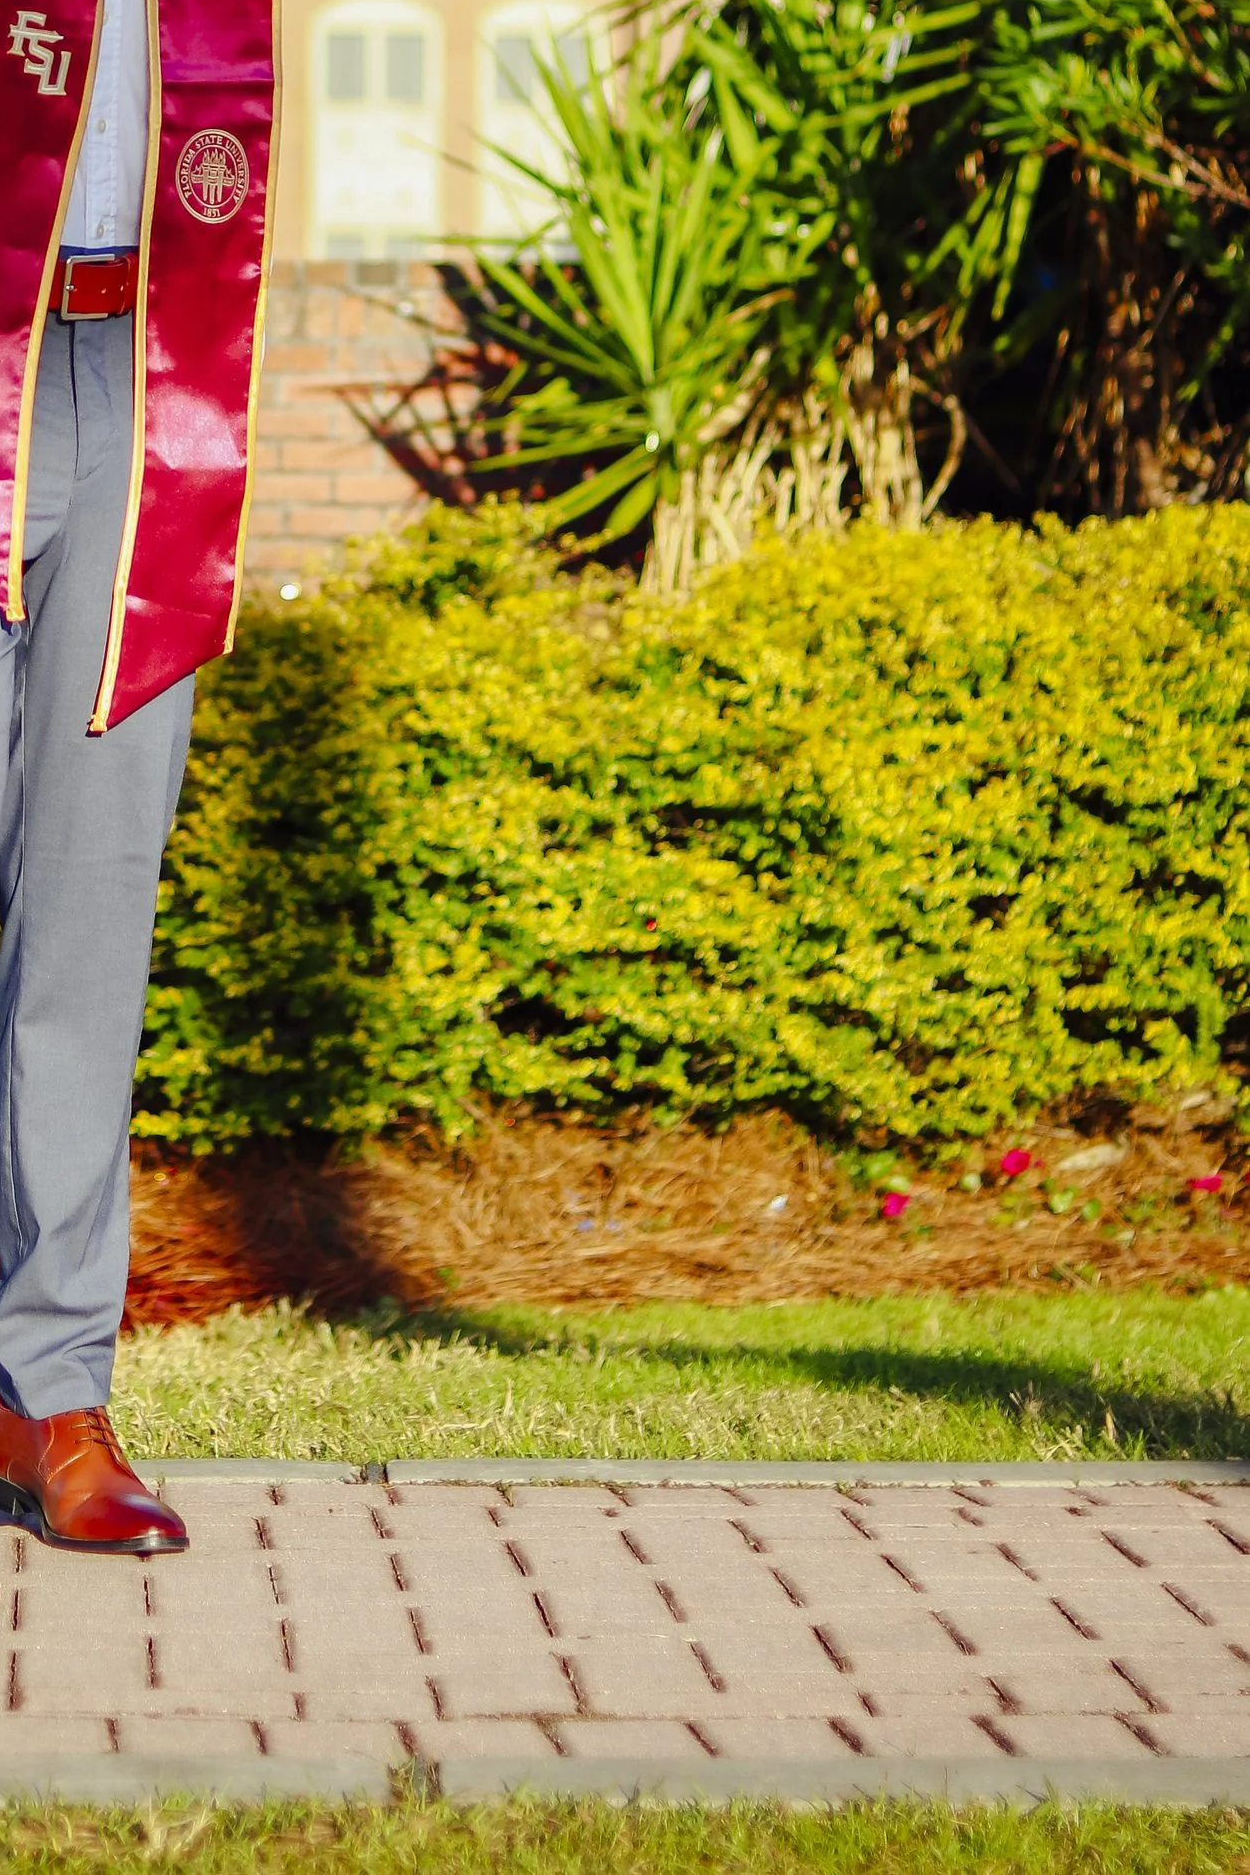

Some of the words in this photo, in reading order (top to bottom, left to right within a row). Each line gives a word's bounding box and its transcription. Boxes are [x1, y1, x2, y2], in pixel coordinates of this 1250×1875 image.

[7, 10, 72, 96] FSU
[180, 148, 196, 199] FLORIDA
[194, 135, 224, 149] STATE
[225, 140, 246, 204] UNIVERSITY
[202, 207, 221, 218] 1851
